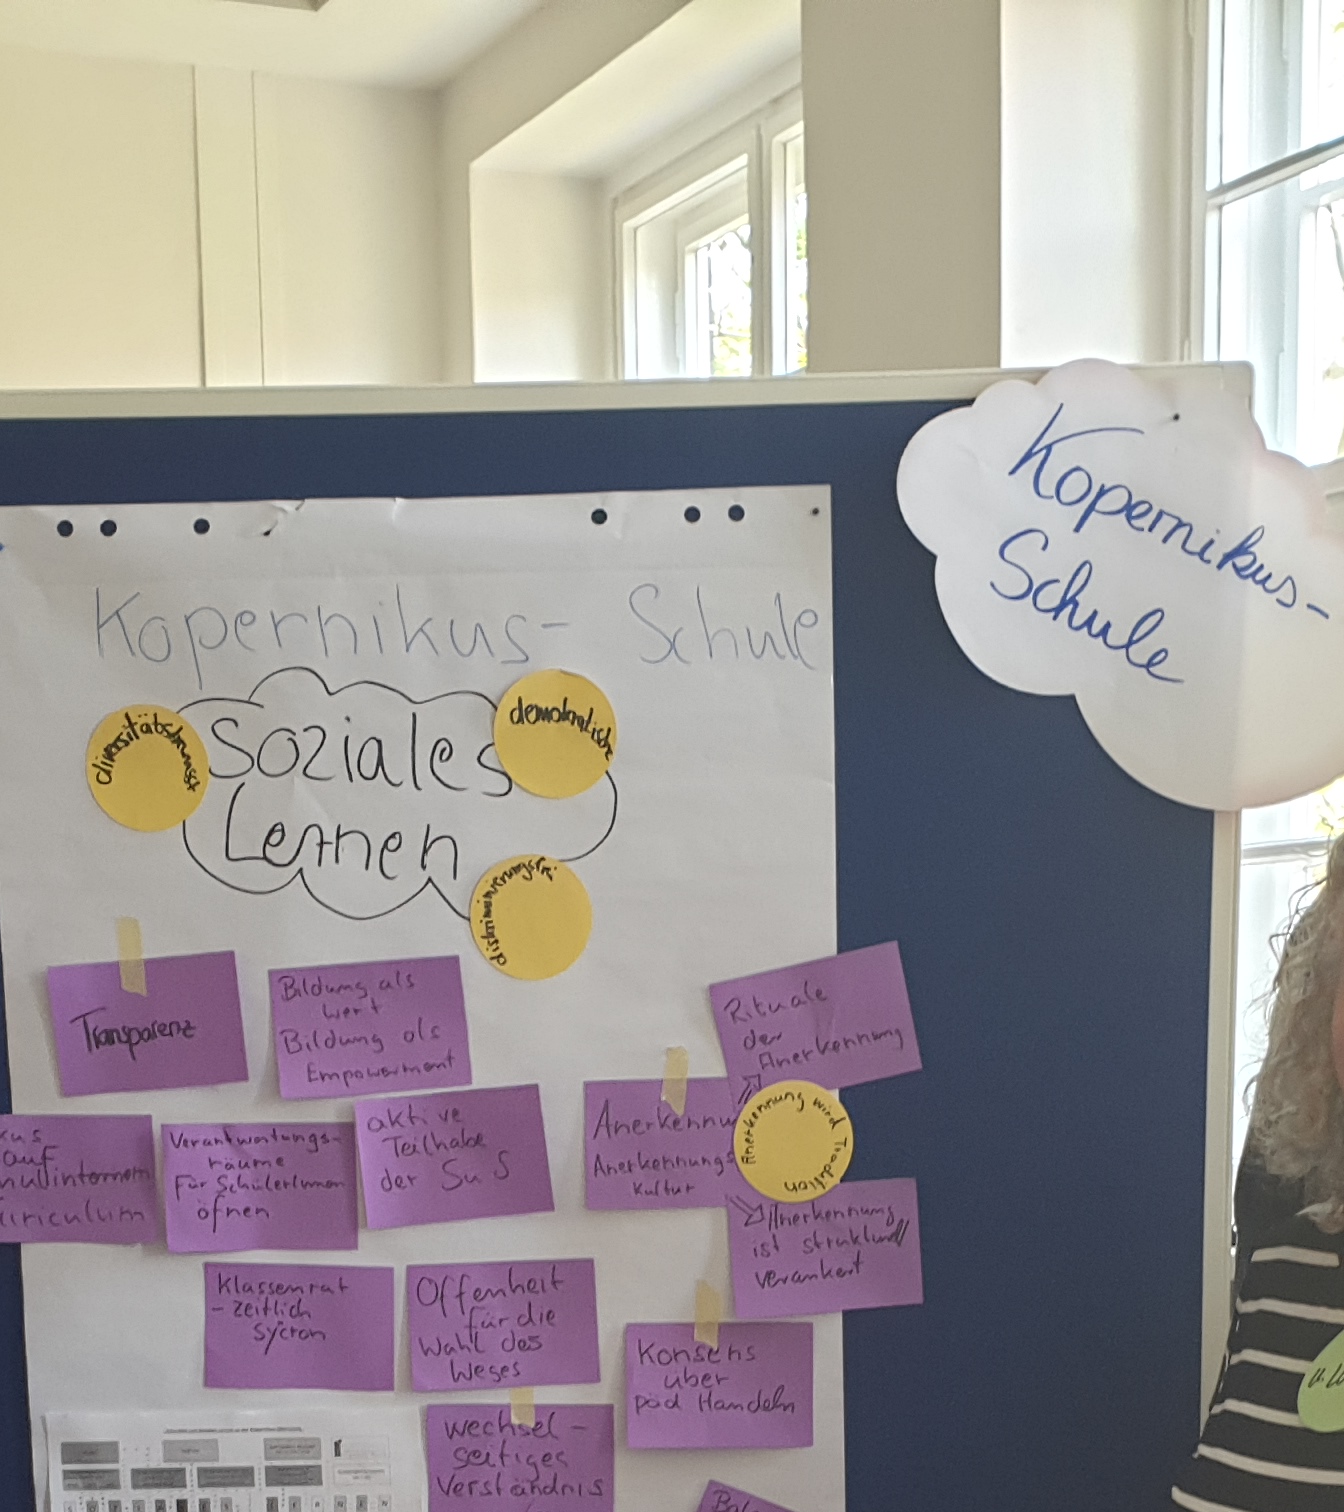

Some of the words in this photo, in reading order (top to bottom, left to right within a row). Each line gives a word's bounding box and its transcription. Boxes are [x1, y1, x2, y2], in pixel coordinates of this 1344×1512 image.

[1008, 402, 1330, 620] Kopernikus-
[990, 528, 1185, 685] Schule
[94, 584, 573, 691] Kopernikus-
[629, 583, 821, 672] Schule
[208, 711, 514, 797] Soziales
[224, 783, 460, 881] Lernen
[278, 975, 369, 1002] Bildung
[378, 970, 416, 992] als
[723, 980, 828, 1025] Rituale
[70, 1006, 197, 1061] Transparenz
[279, 1028, 385, 1055] Bildung
[403, 1016, 441, 1043] als
[743, 1029, 784, 1051] der
[759, 1027, 904, 1071] Anerkennung
[307, 1049, 456, 1088] Empowerment
[366, 1103, 463, 1133] aktive
[812, 1096, 847, 1131] wird
[381, 1128, 488, 1158] Teilhabe
[208, 1156, 285, 1171] räume
[380, 1168, 418, 1193] der
[753, 1233, 780, 1259] ist
[218, 1272, 350, 1296] Klassenrat
[416, 1265, 564, 1318] Offenheit
[465, 1305, 512, 1344] für
[517, 1301, 556, 1329] die
[502, 1331, 544, 1353] des
[637, 1338, 757, 1366] Konsens
[698, 1384, 796, 1414] Handeln
[436, 1474, 606, 1498] Verständnis
